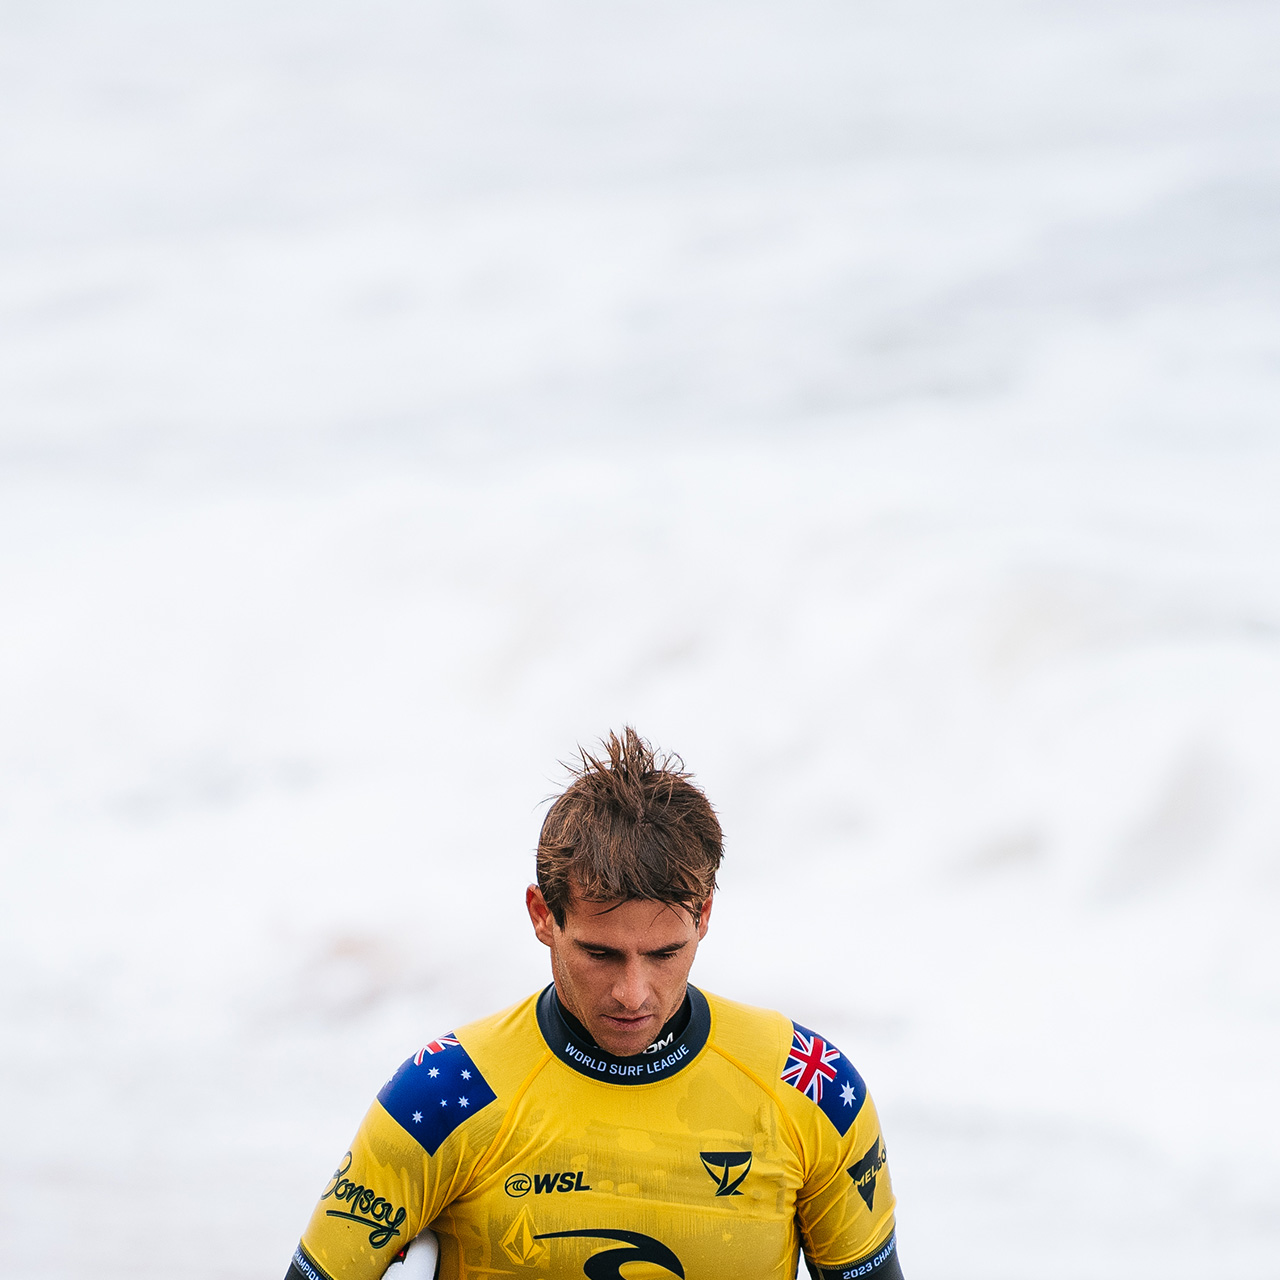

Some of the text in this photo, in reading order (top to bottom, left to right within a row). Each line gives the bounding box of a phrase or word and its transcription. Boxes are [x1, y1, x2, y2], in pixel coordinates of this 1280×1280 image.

[564, 1042, 607, 1072] WORLD
[609, 1063, 644, 1076] SURF
[646, 1043, 690, 1074] LEAGUE
[853, 1146, 887, 1188] MELBO
[534, 1171, 590, 1194] WSL
[842, 1261, 873, 1280] 2023
